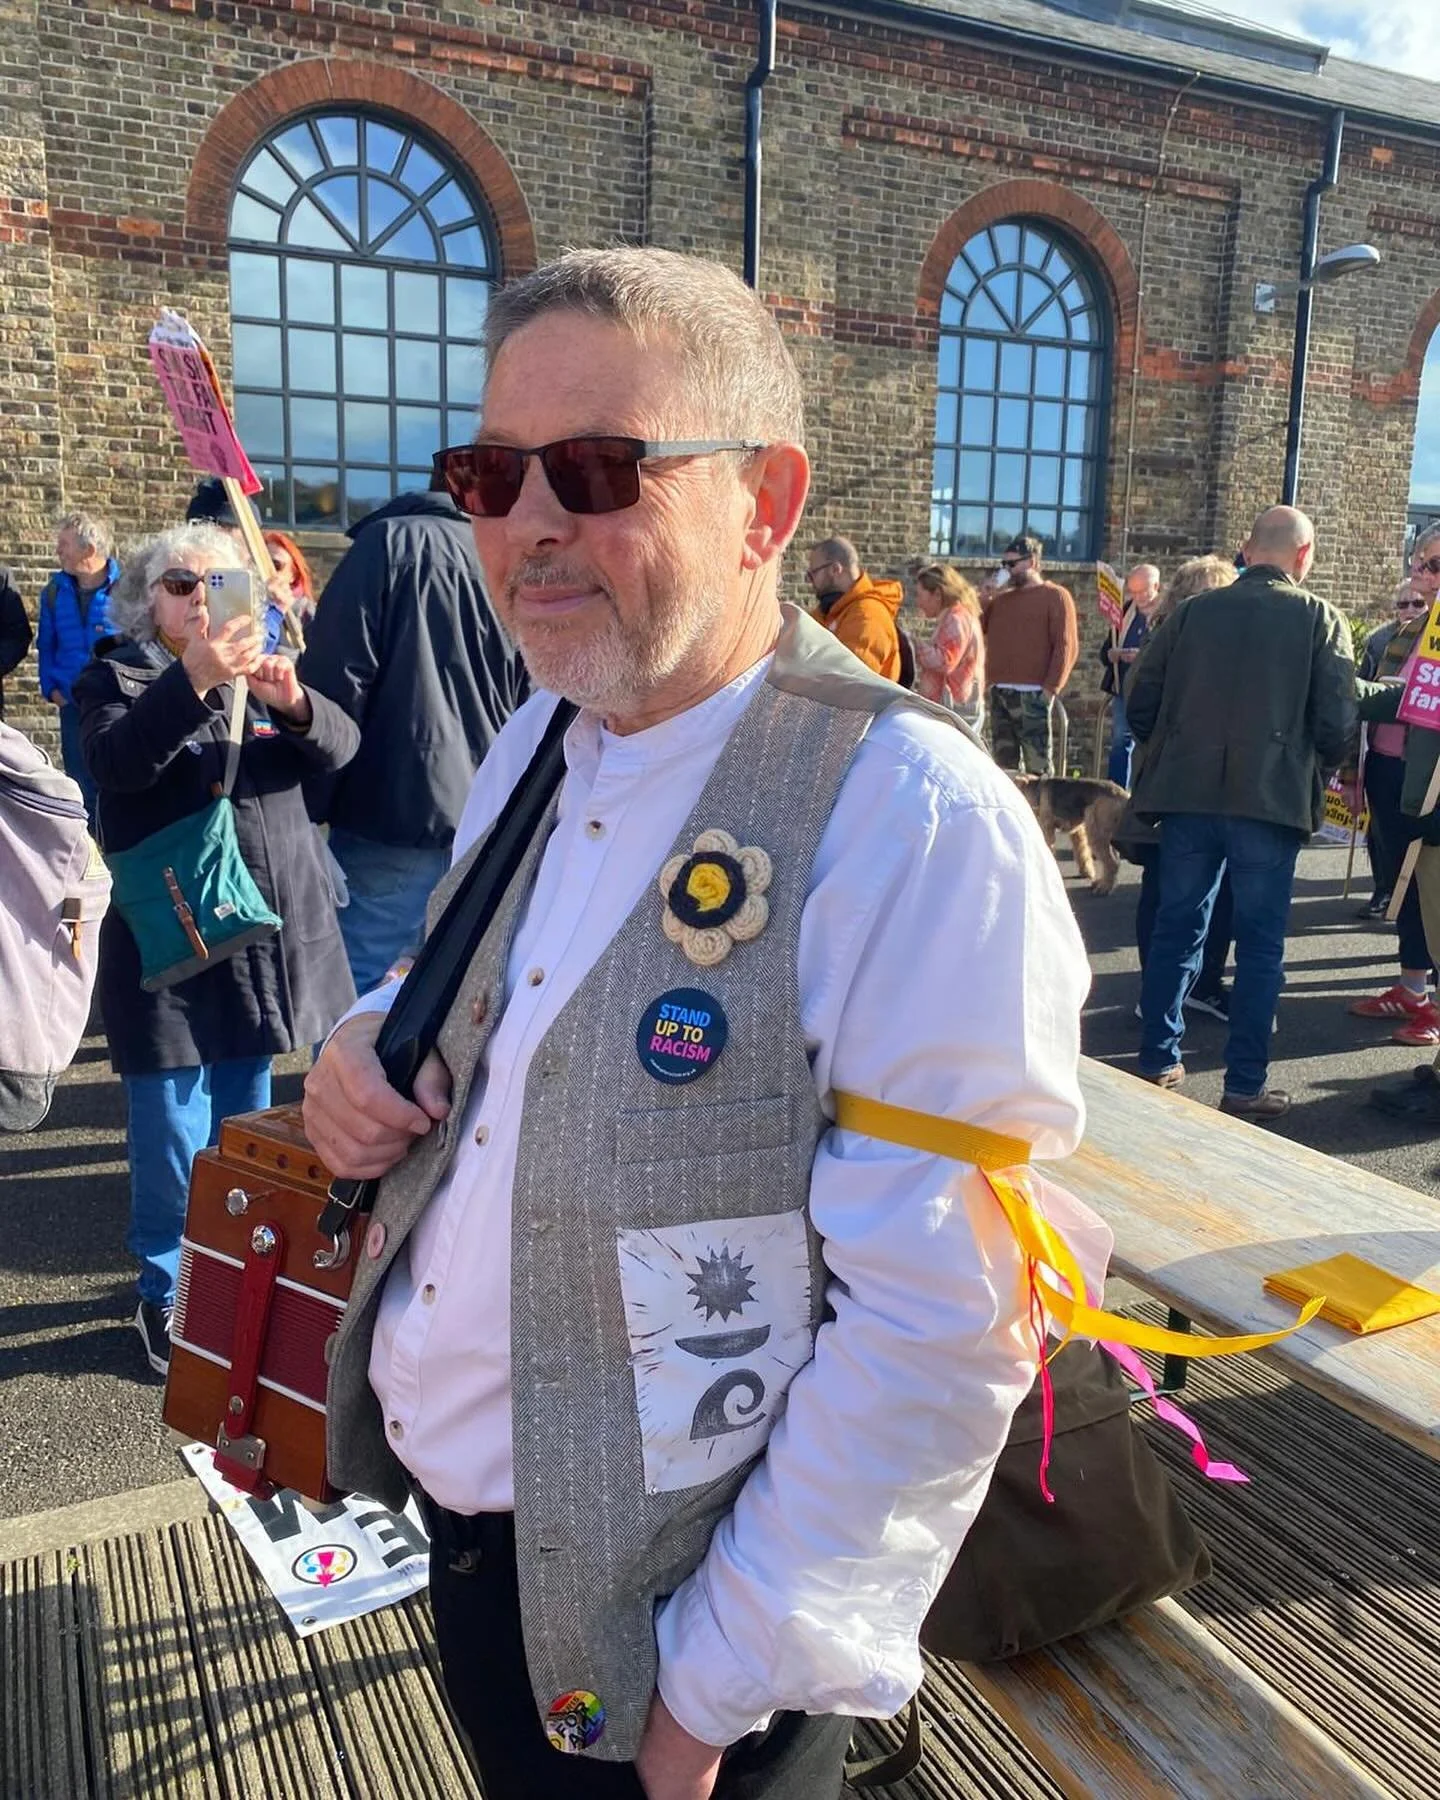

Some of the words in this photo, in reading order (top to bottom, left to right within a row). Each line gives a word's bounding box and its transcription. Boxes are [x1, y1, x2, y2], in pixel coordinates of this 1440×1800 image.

[659, 1003, 711, 1027] STAND
[655, 1019, 678, 1036] UP
[683, 1025, 704, 1043] TO
[650, 1035, 711, 1062] RACISM
